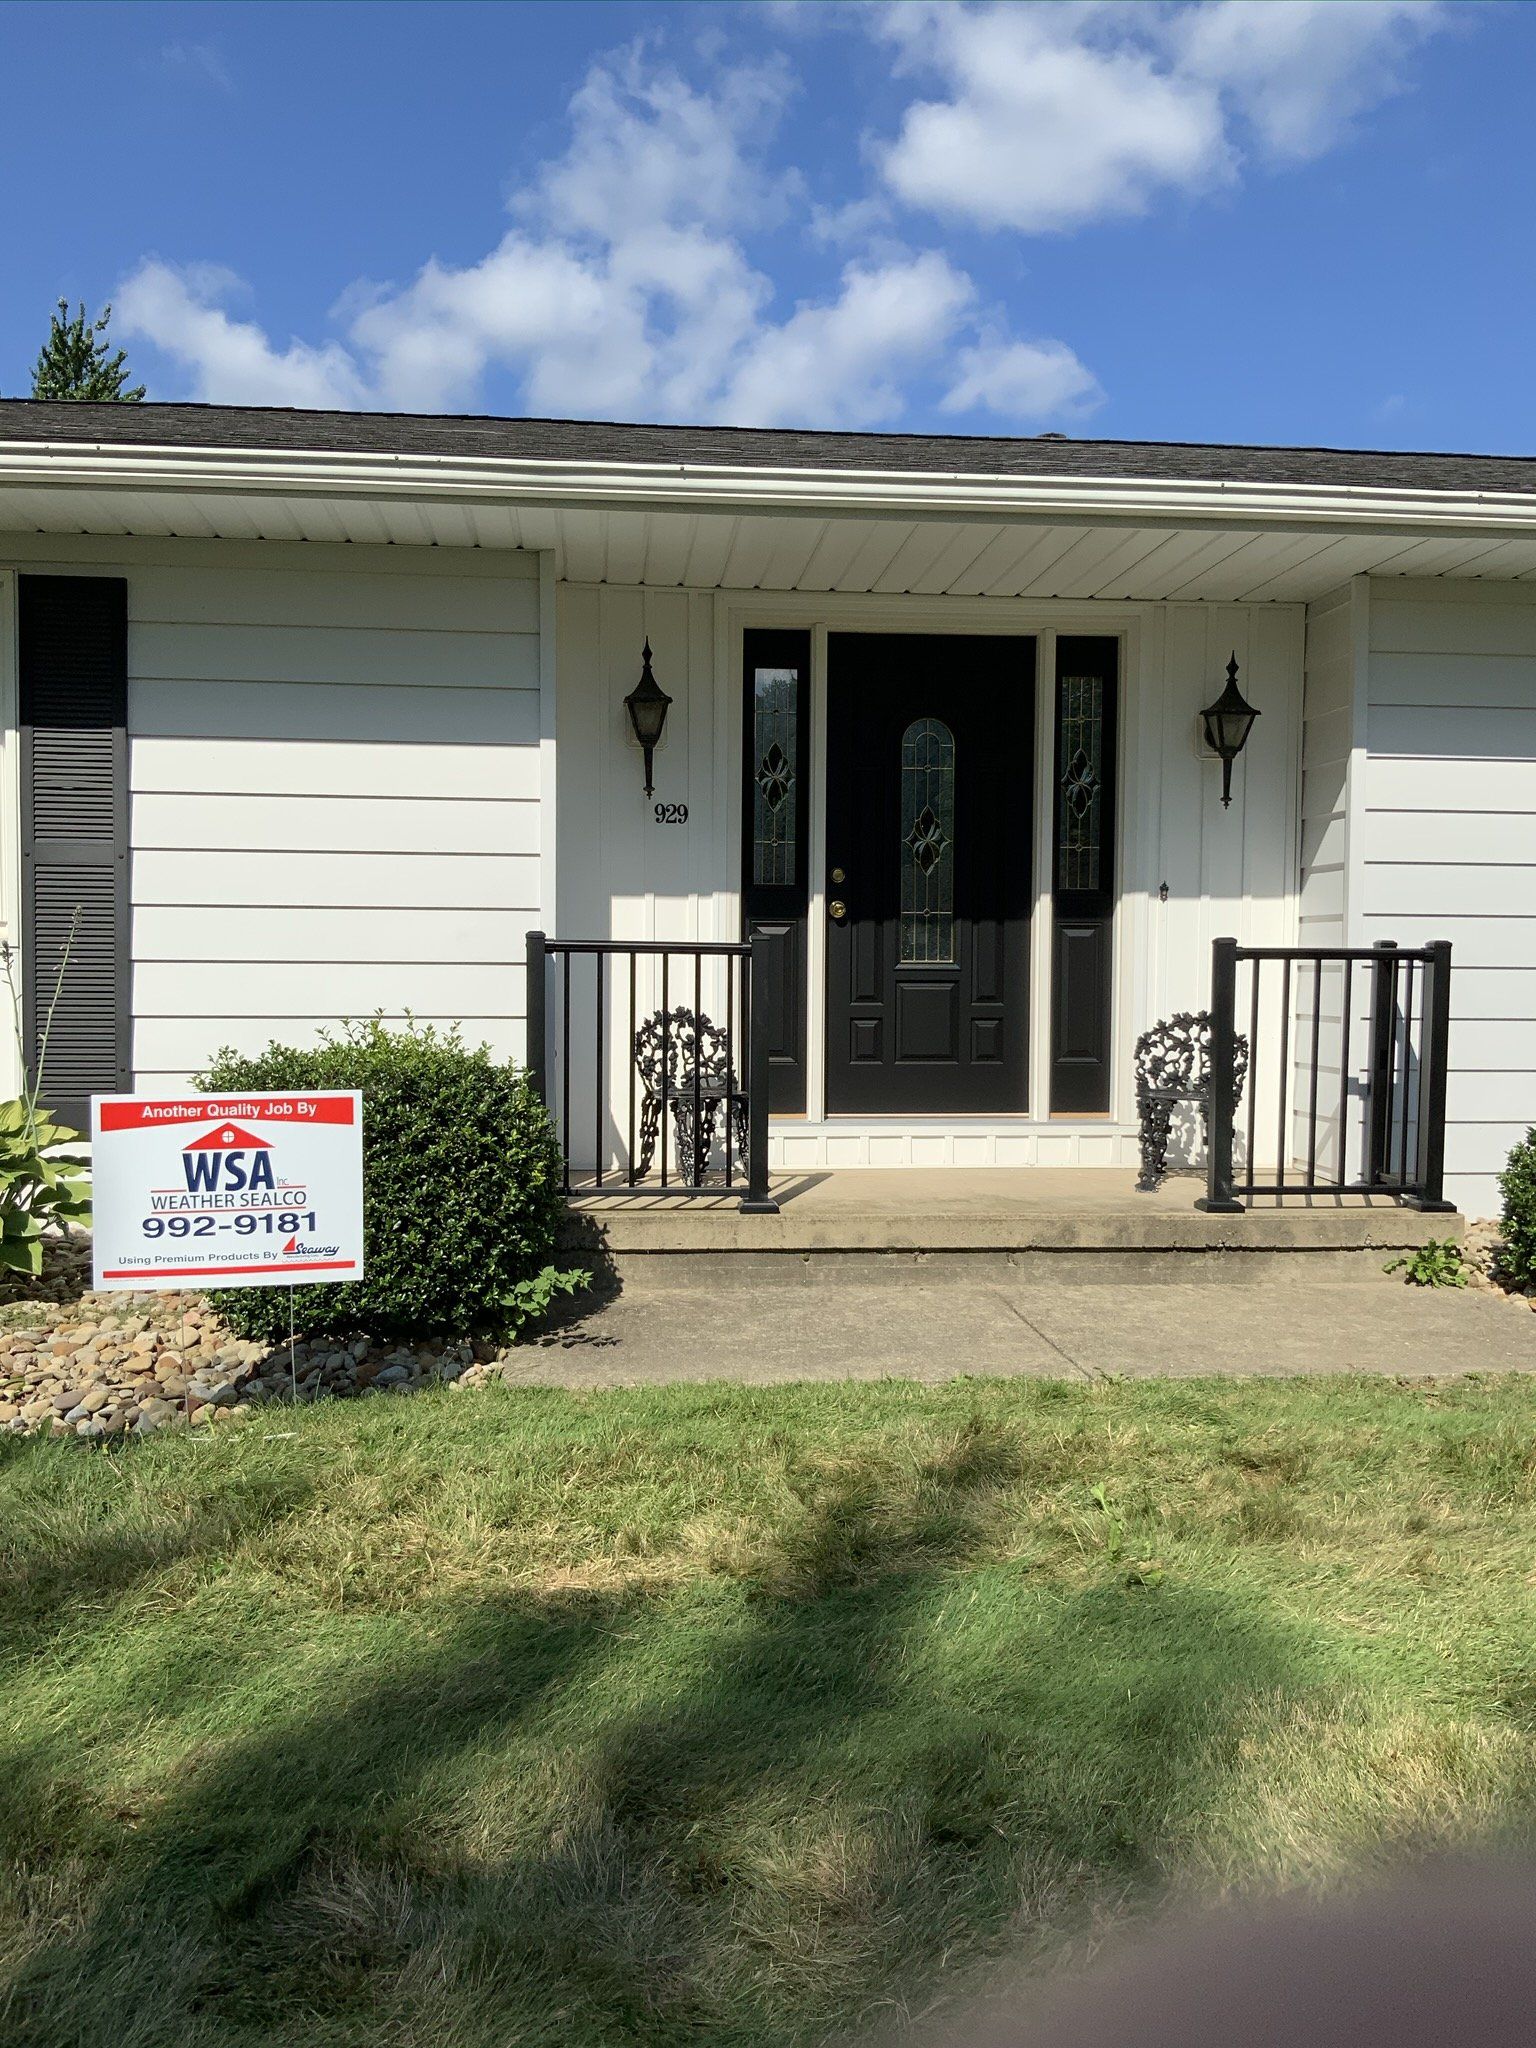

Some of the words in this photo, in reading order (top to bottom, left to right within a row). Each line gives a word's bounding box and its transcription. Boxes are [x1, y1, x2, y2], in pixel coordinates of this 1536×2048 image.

[654, 803, 689, 824] 929
[141, 1104, 203, 1118] Another
[207, 1103, 261, 1118] Quality
[264, 1102, 293, 1115] Job
[297, 1101, 317, 1116] By
[182, 1150, 276, 1192] WSA
[151, 1194, 235, 1210] WEATHER
[240, 1191, 307, 1208] SEALCO
[142, 1211, 316, 1239] 992-9181
[118, 1256, 152, 1265] Using
[154, 1254, 205, 1264] Premium
[208, 1252, 260, 1262] Products
[263, 1251, 278, 1260] By
[287, 1242, 340, 1257] Seaway
